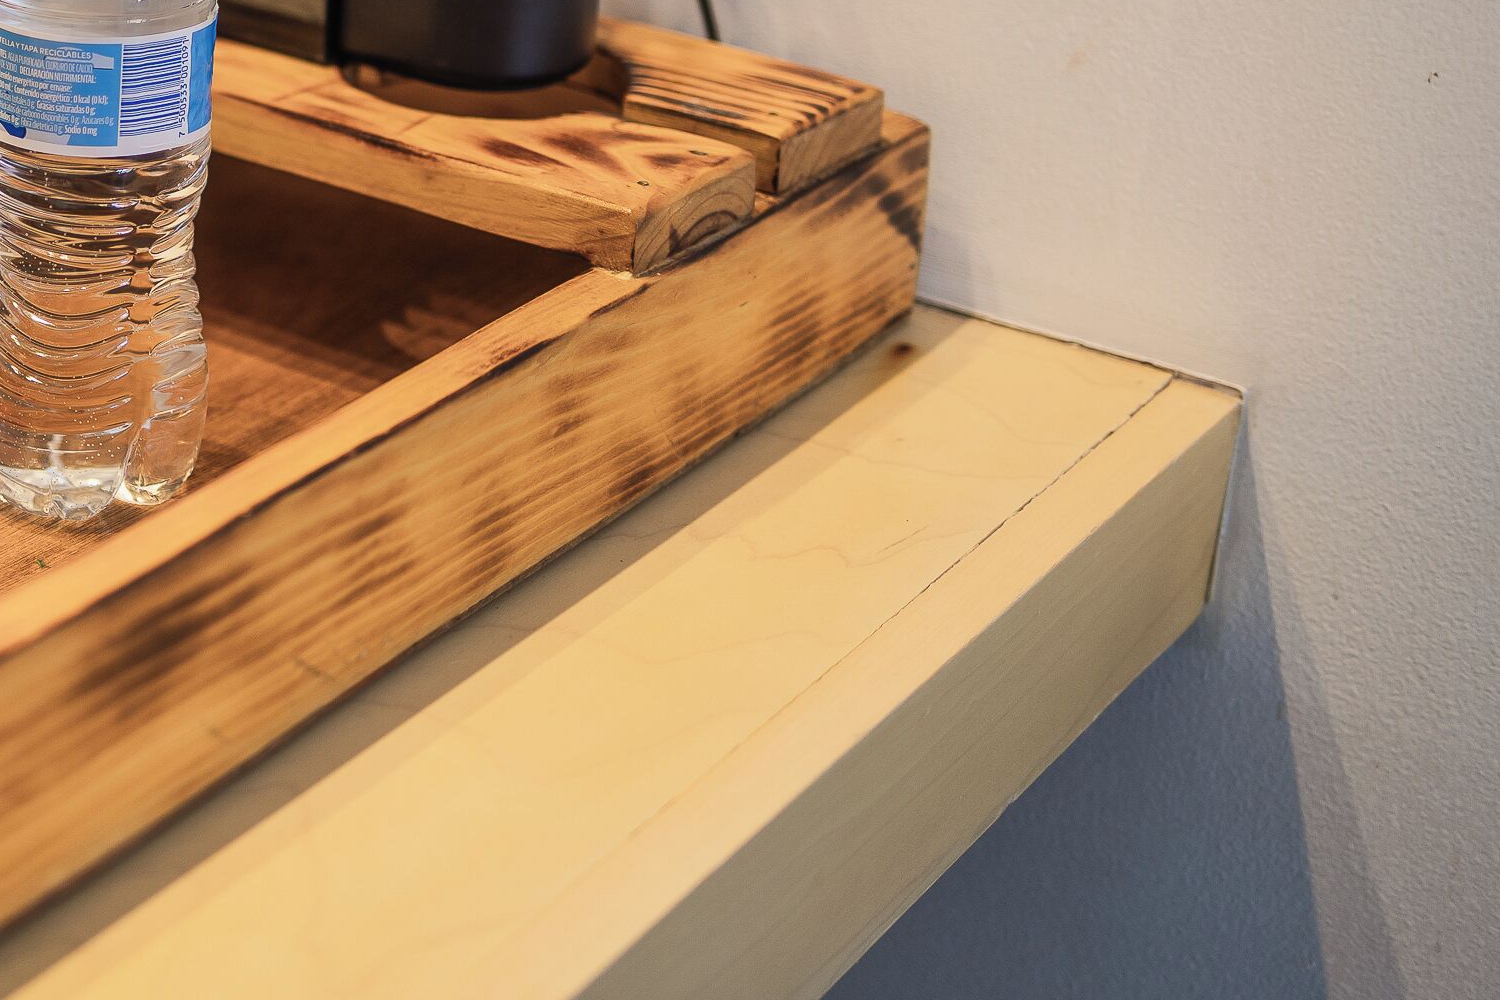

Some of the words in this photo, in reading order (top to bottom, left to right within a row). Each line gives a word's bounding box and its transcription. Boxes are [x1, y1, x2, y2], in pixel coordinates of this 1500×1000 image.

[21, 44, 38, 54] TAPA
[40, 48, 92, 59] RECICLABLES
[39, 82, 49, 91] por
[64, 125, 81, 134] Sodio
[87, 128, 97, 136] mg
